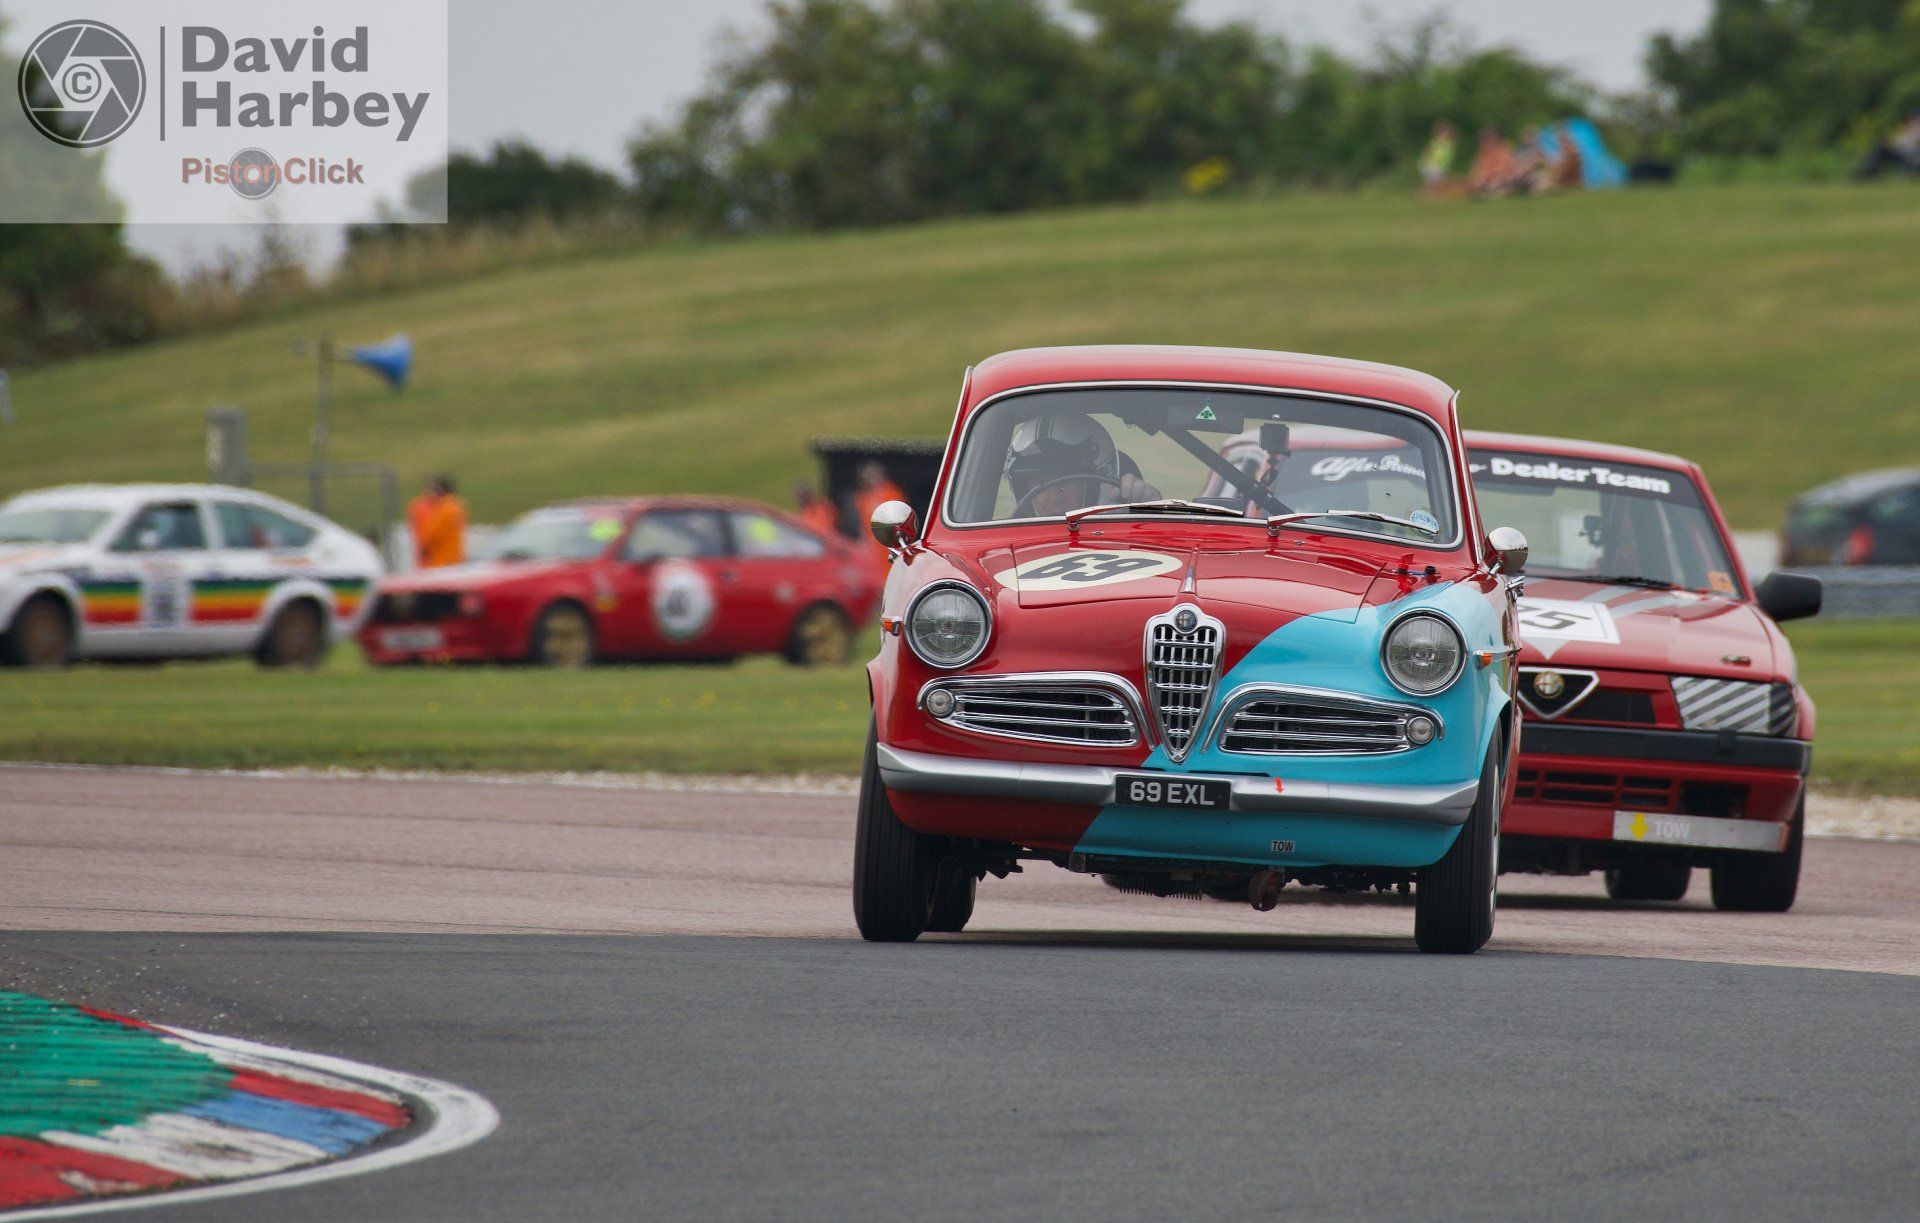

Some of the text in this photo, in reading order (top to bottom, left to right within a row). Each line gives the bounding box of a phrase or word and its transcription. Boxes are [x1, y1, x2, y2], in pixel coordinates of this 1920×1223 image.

[1311, 456, 1378, 481] Alfa
[1491, 457, 1589, 482] Dealer
[1591, 467, 1670, 494] Team
[1018, 553, 1163, 581] 69
[1130, 781, 1215, 806] 69 EXL
[1654, 820, 1690, 839] TOW
[1272, 840, 1294, 852] TOW
